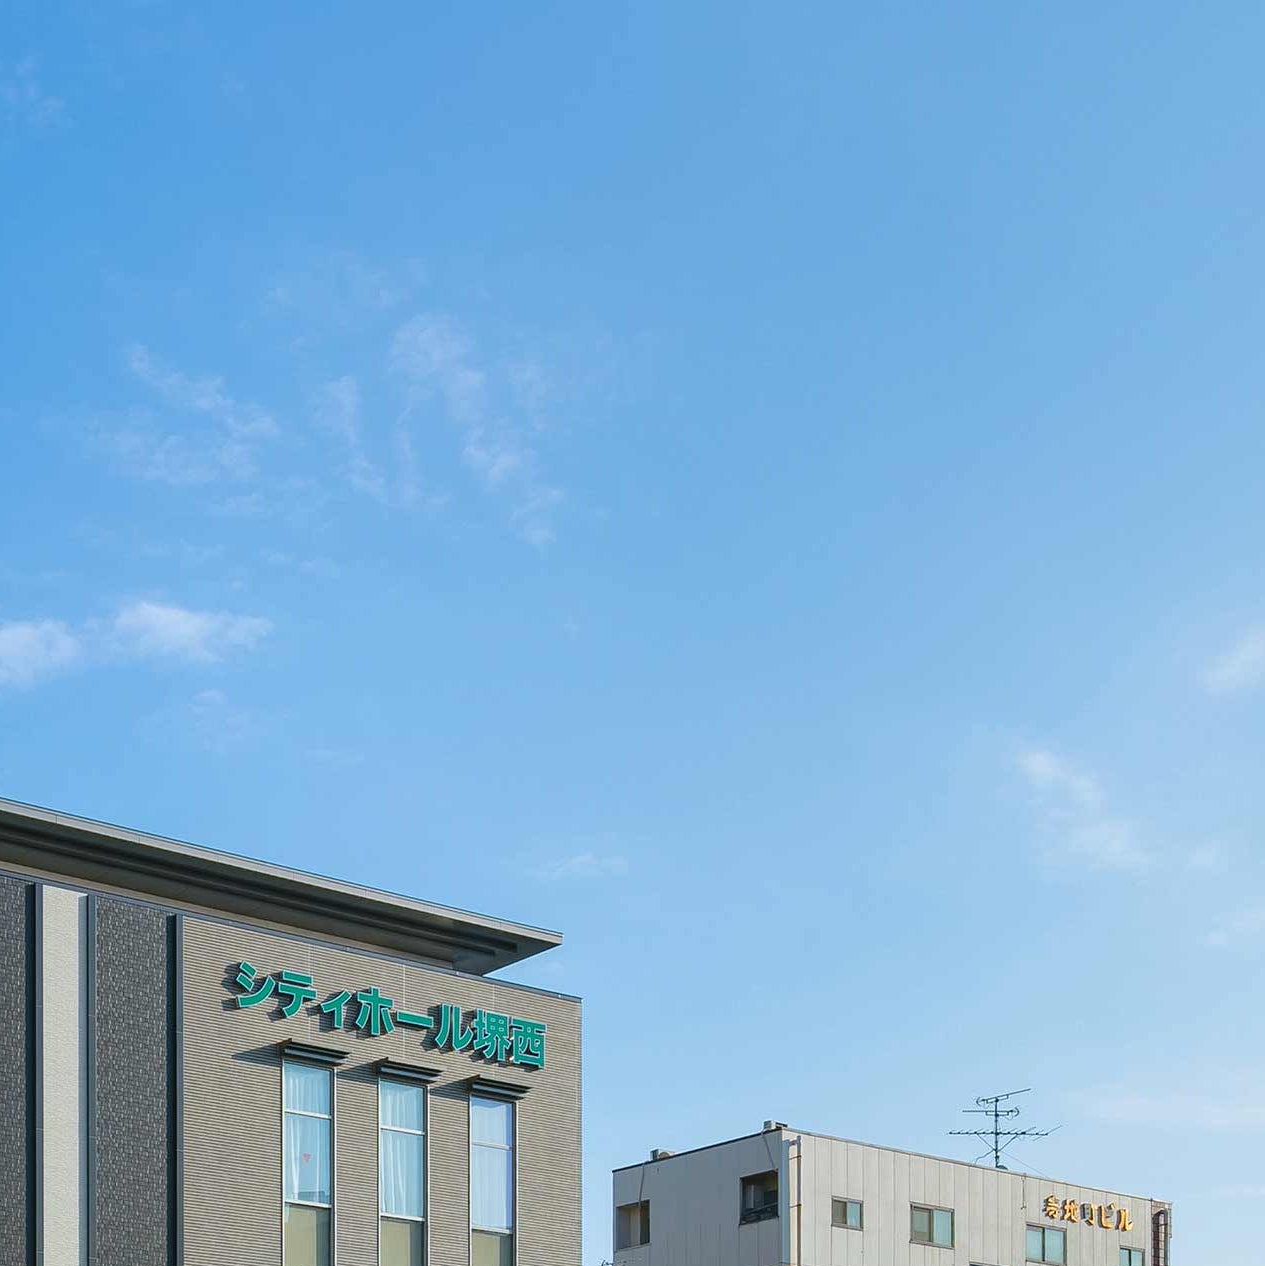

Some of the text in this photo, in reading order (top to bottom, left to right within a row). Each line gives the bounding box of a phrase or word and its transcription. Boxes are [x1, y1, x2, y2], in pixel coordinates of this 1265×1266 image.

[235, 960, 548, 1069] シティホール堺西
